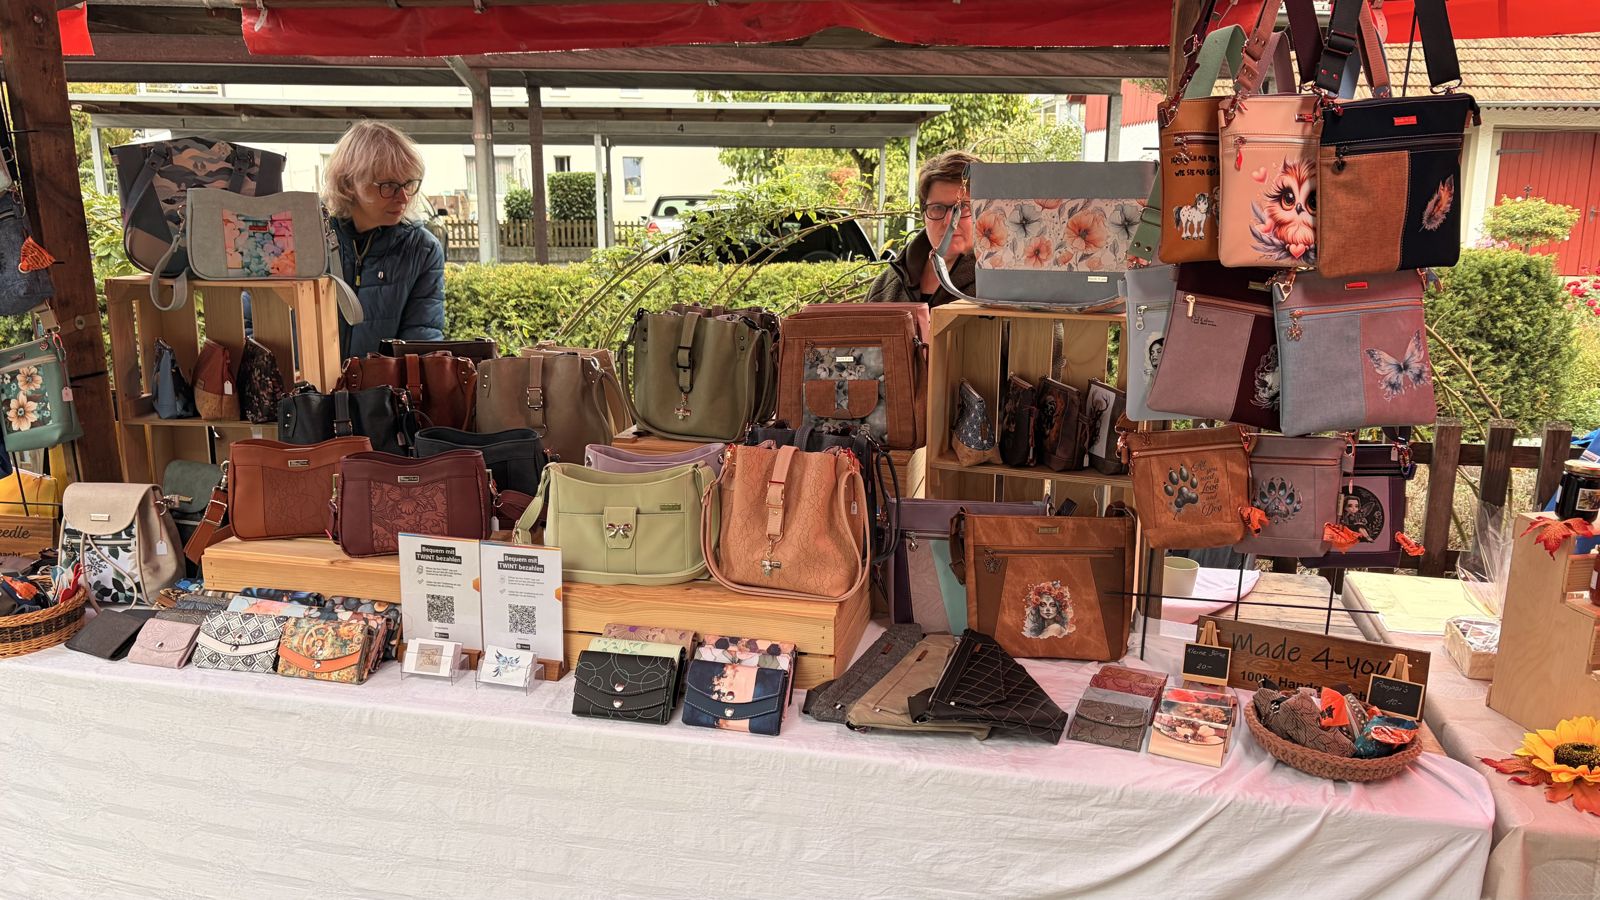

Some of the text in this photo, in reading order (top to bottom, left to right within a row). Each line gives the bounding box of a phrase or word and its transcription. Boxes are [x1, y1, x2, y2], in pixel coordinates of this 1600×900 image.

[180, 118, 186, 129] 1
[507, 122, 515, 132] 3
[677, 123, 685, 133] 4
[829, 124, 836, 135] 5
[421, 546, 445, 555] Bequem
[416, 553, 435, 561] TWINT
[504, 555, 527, 563] Bequem
[498, 562, 544, 572] TWINT bezahlen
[1231, 632, 1391, 680] Made 4-you
